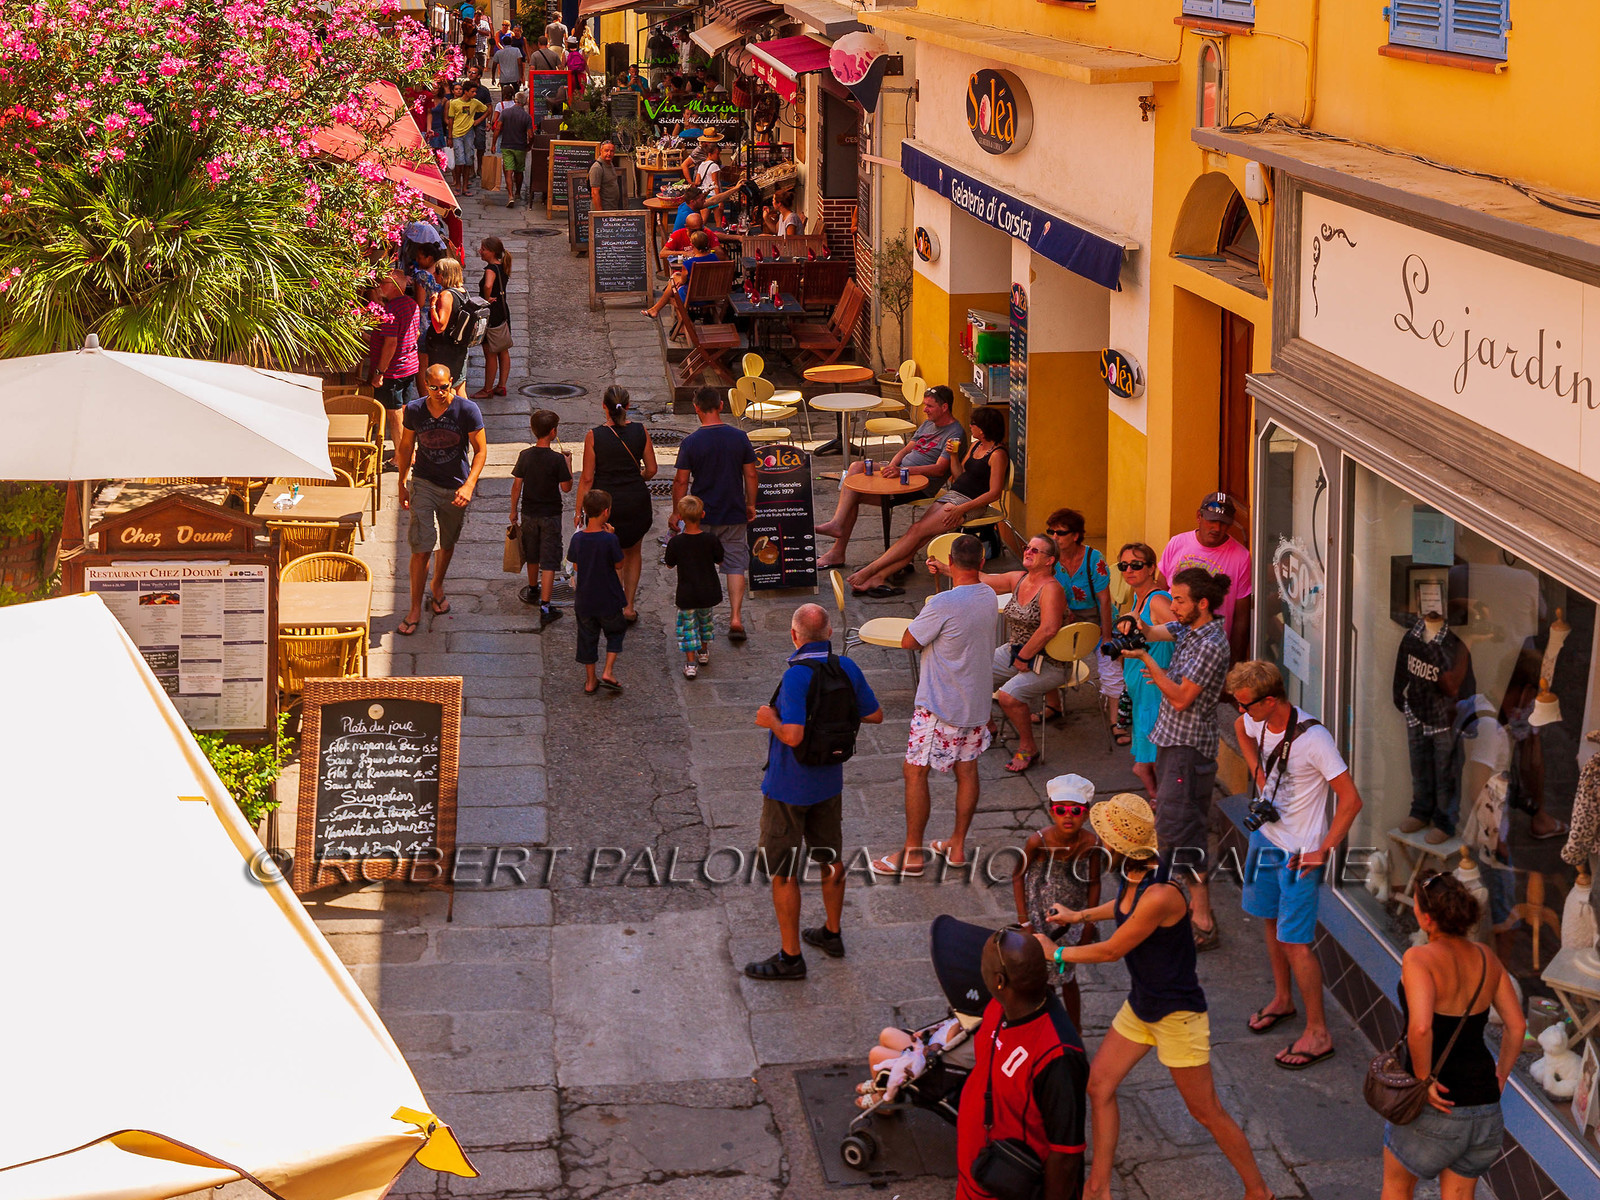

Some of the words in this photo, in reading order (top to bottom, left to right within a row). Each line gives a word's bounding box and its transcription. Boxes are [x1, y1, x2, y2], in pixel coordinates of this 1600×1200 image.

[644, 96, 681, 119] Via
[968, 73, 1015, 144] Soléa
[951, 178, 985, 217] Gelateria
[997, 202, 1032, 243] Corsica
[1393, 253, 1455, 348] Le
[1454, 306, 1600, 410] jardin
[1100, 348, 1134, 396] Soléa
[773, 481, 802, 489] artisanales
[120, 527, 162, 547] Chez
[177, 525, 233, 544] Doumé
[89, 569, 148, 578] RESTAURANT
[149, 568, 180, 578] CHEZ
[182, 567, 223, 577] DOUMÉ
[1407, 653, 1440, 683] HEROES
[341, 716, 367, 733] Plats
[369, 721, 384, 732] du
[325, 753, 354, 767] Sauce
[324, 779, 352, 791] Sauce
